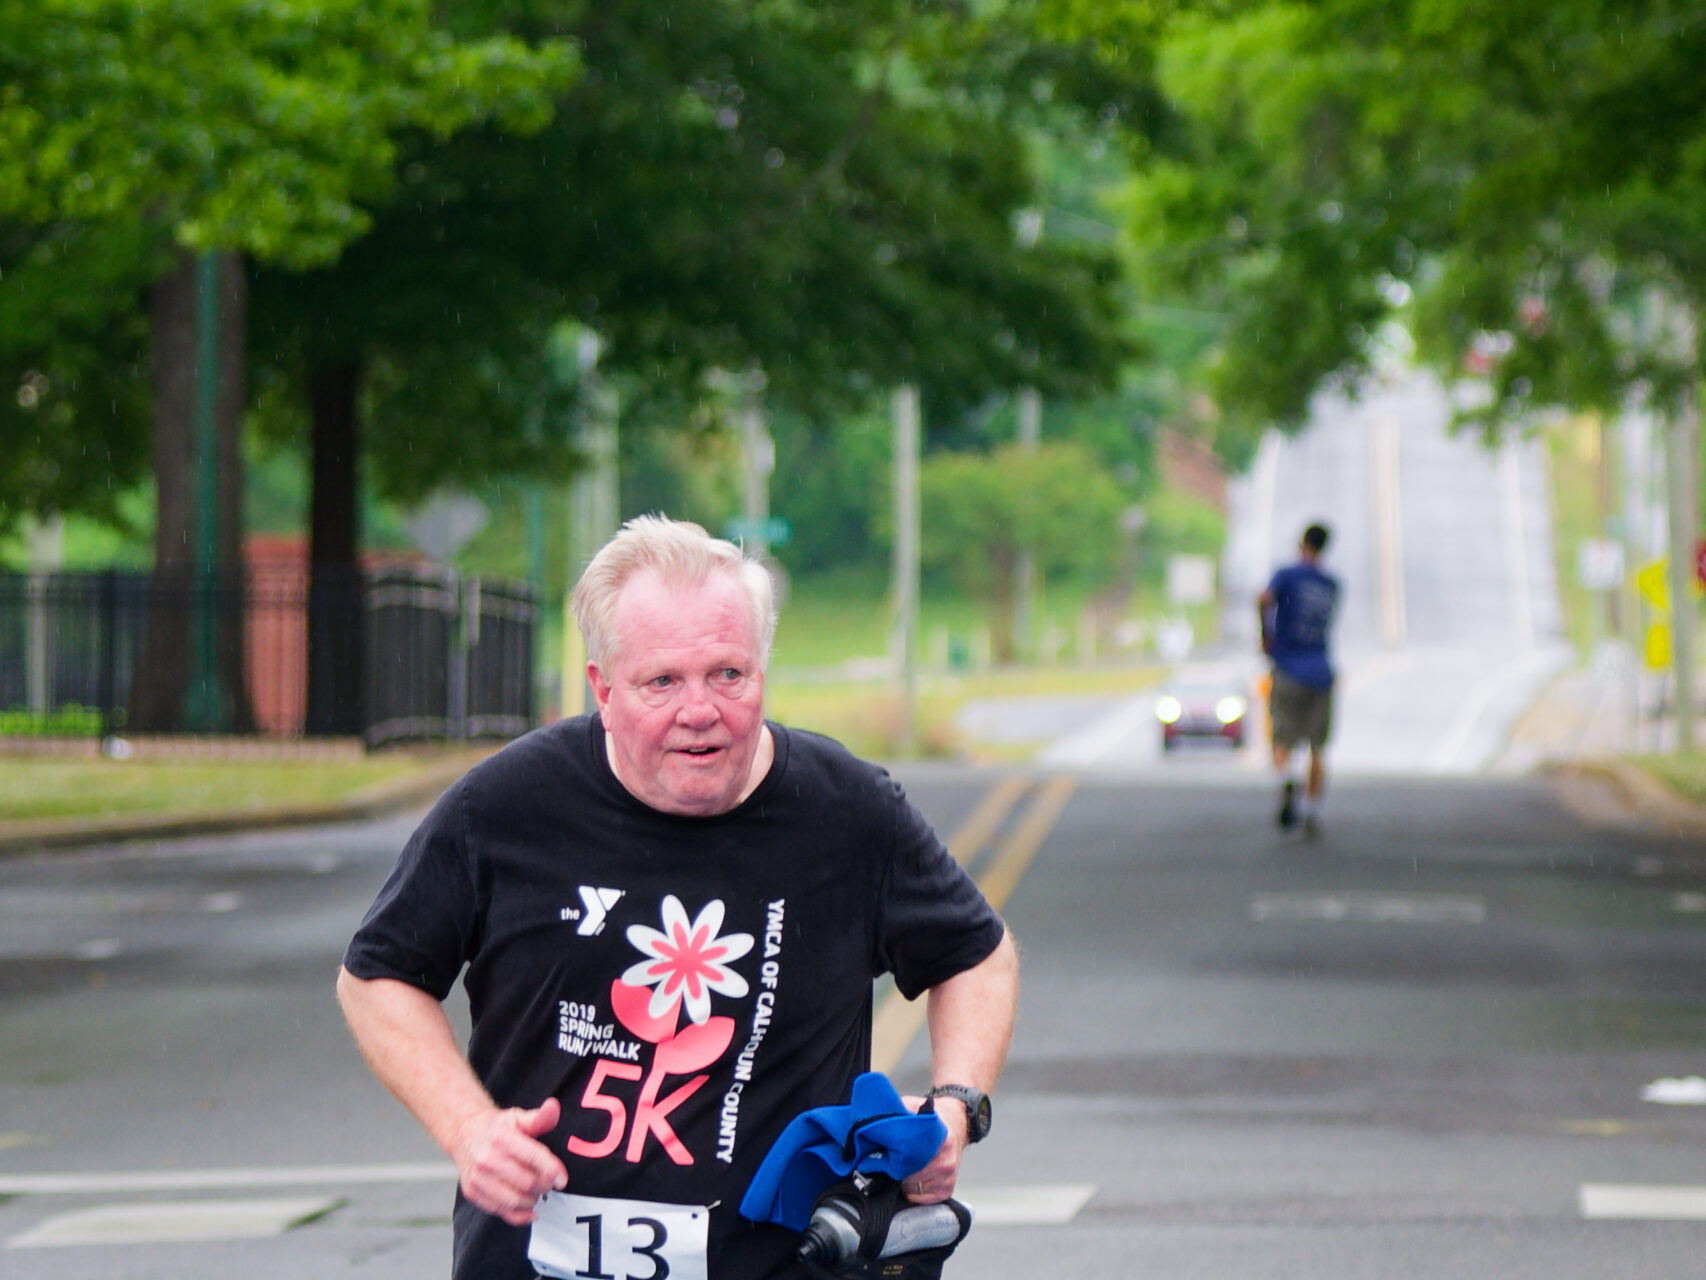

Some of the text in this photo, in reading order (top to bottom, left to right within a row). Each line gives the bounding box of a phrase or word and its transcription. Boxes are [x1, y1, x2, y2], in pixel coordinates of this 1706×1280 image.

[560, 907, 580, 921] the
[558, 1000, 596, 1022] 2019
[559, 1015, 615, 1041] SPRING
[716, 898, 785, 1164] YMCA OF CALHOUN COUNTY
[558, 1032, 641, 1062] RUN/WALK
[567, 1059, 710, 1165] 5K
